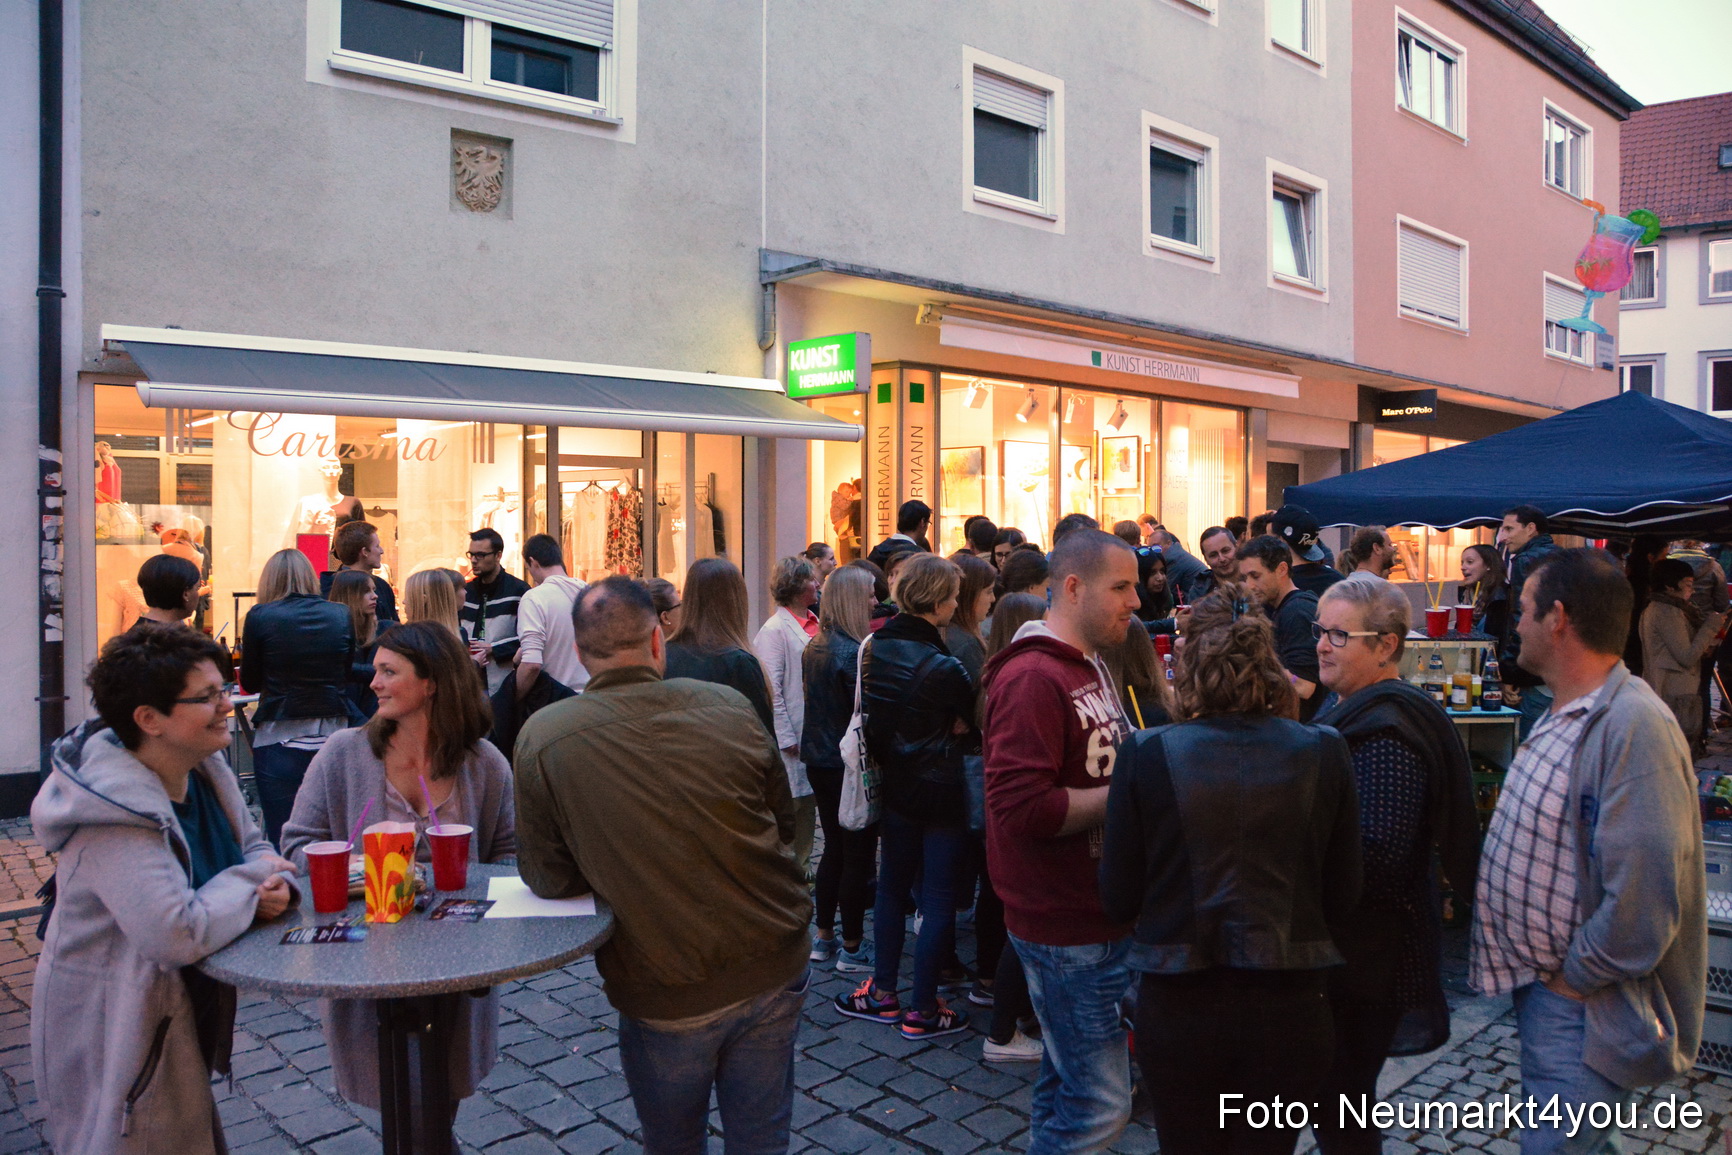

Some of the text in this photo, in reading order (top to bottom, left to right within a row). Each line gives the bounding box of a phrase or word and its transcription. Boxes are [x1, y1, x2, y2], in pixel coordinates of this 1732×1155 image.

[790, 344, 840, 371] KUNST
[1106, 353, 1200, 382] KUNST HERRMANN
[799, 369, 854, 389] HERRMANN
[1382, 406, 1433, 417] Marc O'Polo
[227, 410, 447, 462] Carisma
[911, 425, 924, 499] RMANN
[878, 425, 890, 536] HERRMANN
